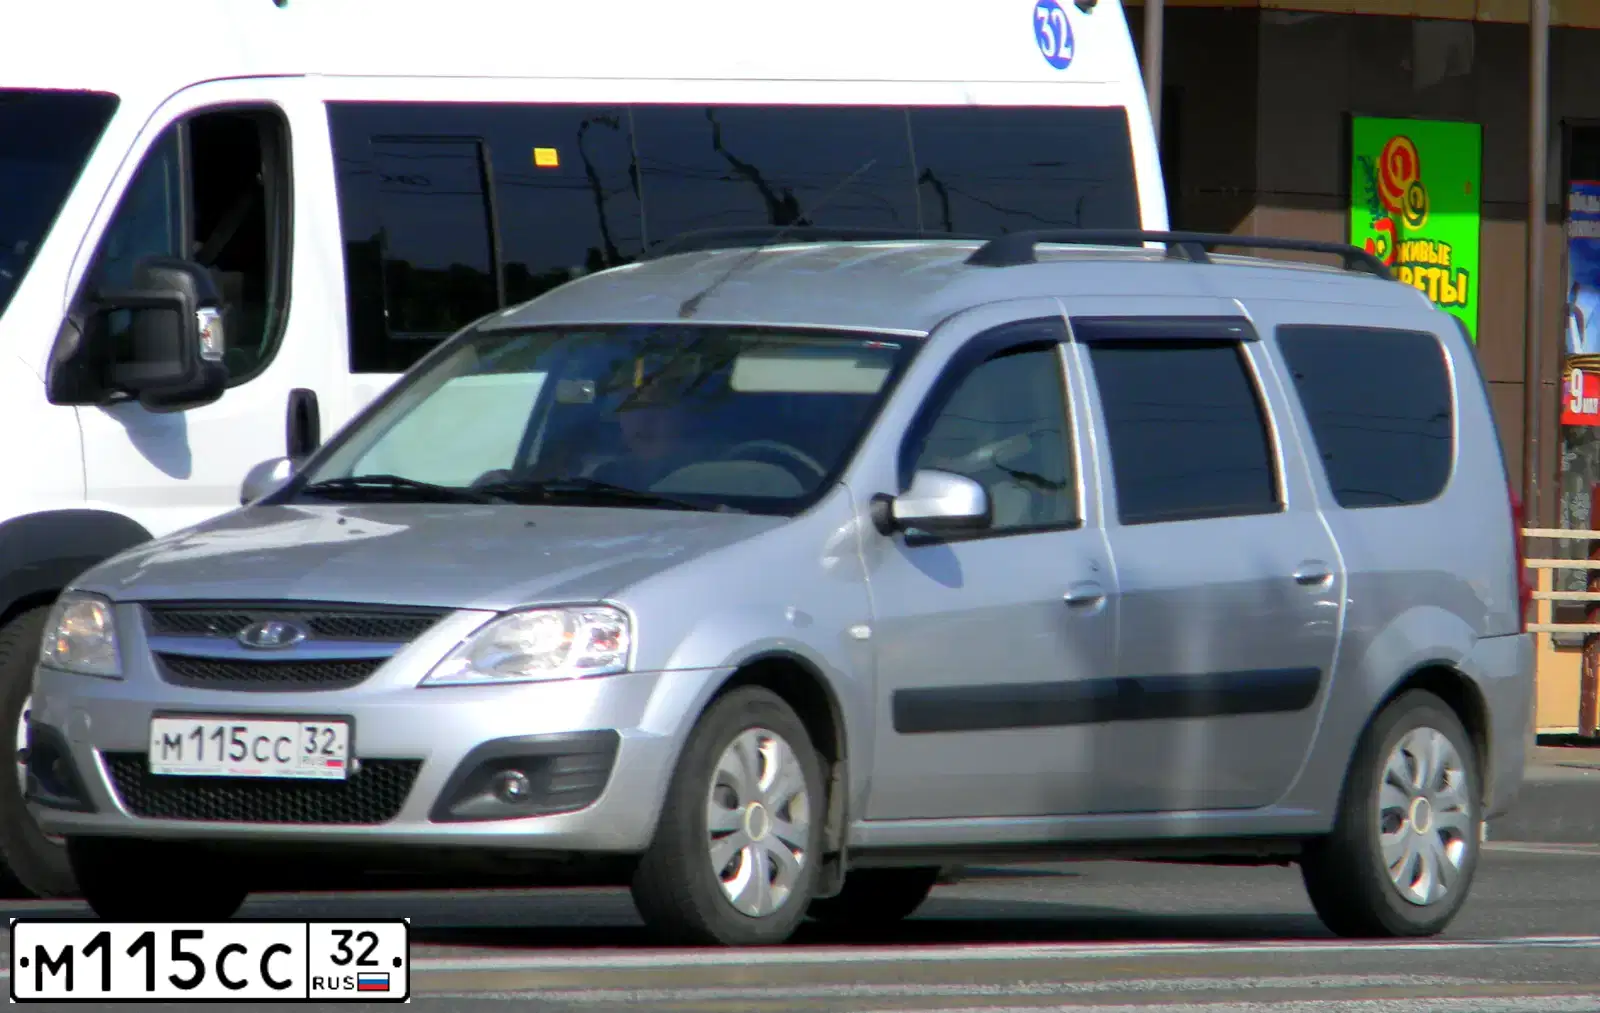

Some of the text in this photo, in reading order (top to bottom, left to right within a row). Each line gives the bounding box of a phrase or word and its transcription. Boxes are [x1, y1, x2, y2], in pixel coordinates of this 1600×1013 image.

[1037, 6, 1072, 60] 32
[1390, 266, 1467, 303] ВЕТЫ
[1570, 368, 1583, 413] 9
[161, 725, 336, 763] М115СС 32
